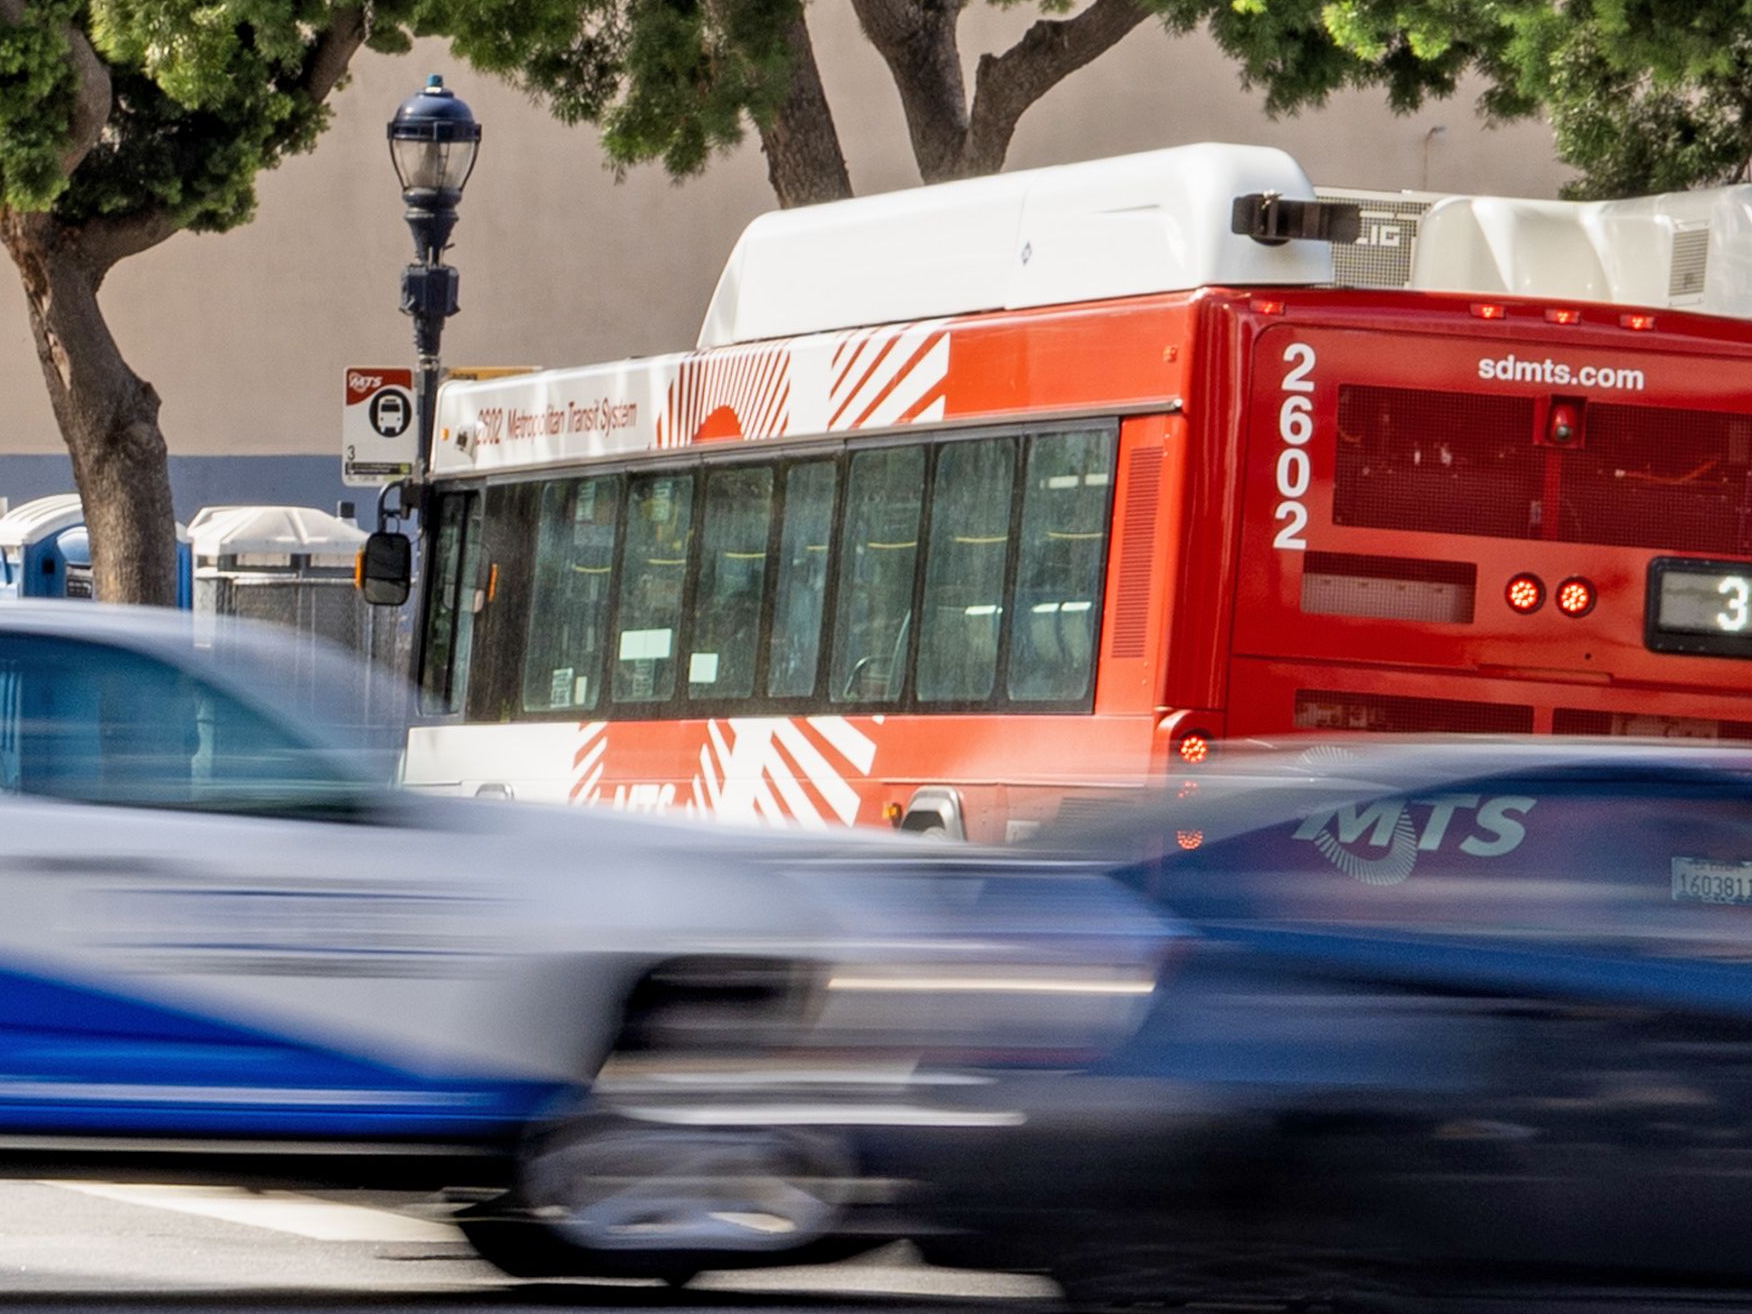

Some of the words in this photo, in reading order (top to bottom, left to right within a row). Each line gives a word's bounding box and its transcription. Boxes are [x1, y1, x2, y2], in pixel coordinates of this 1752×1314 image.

[1478, 355, 1645, 390] sdmts.com
[1273, 342, 1316, 551] 2602
[1716, 575, 1748, 632] 3
[1292, 793, 1537, 857] MTS
